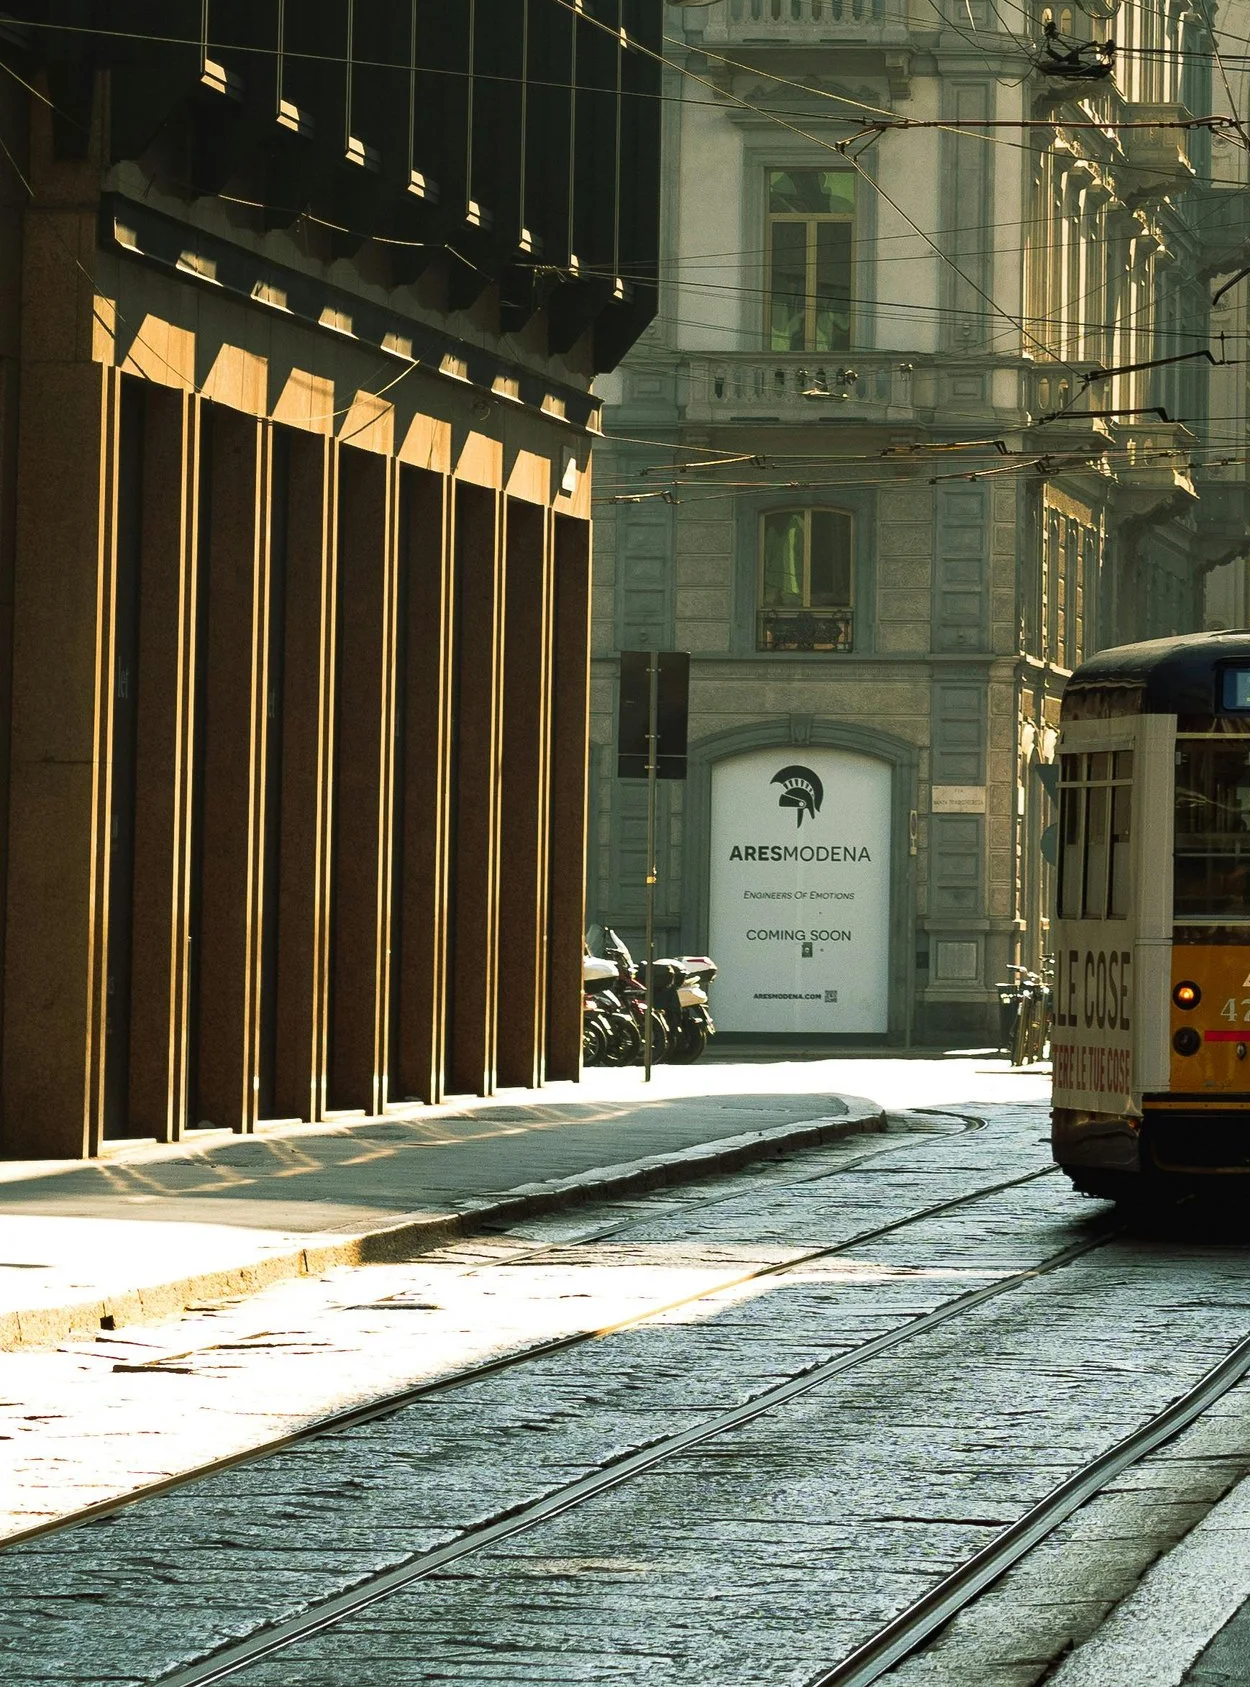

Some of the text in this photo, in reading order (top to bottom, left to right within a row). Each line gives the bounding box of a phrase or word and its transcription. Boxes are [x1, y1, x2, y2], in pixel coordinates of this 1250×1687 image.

[729, 846, 872, 862] ARESMODENA
[746, 929, 851, 941] COMING SOON
[1052, 950, 1131, 1030] LE COSE
[1076, 1046, 1086, 1091] LE
[1088, 1046, 1105, 1092] TUE
[1107, 1047, 1130, 1095] COSE
